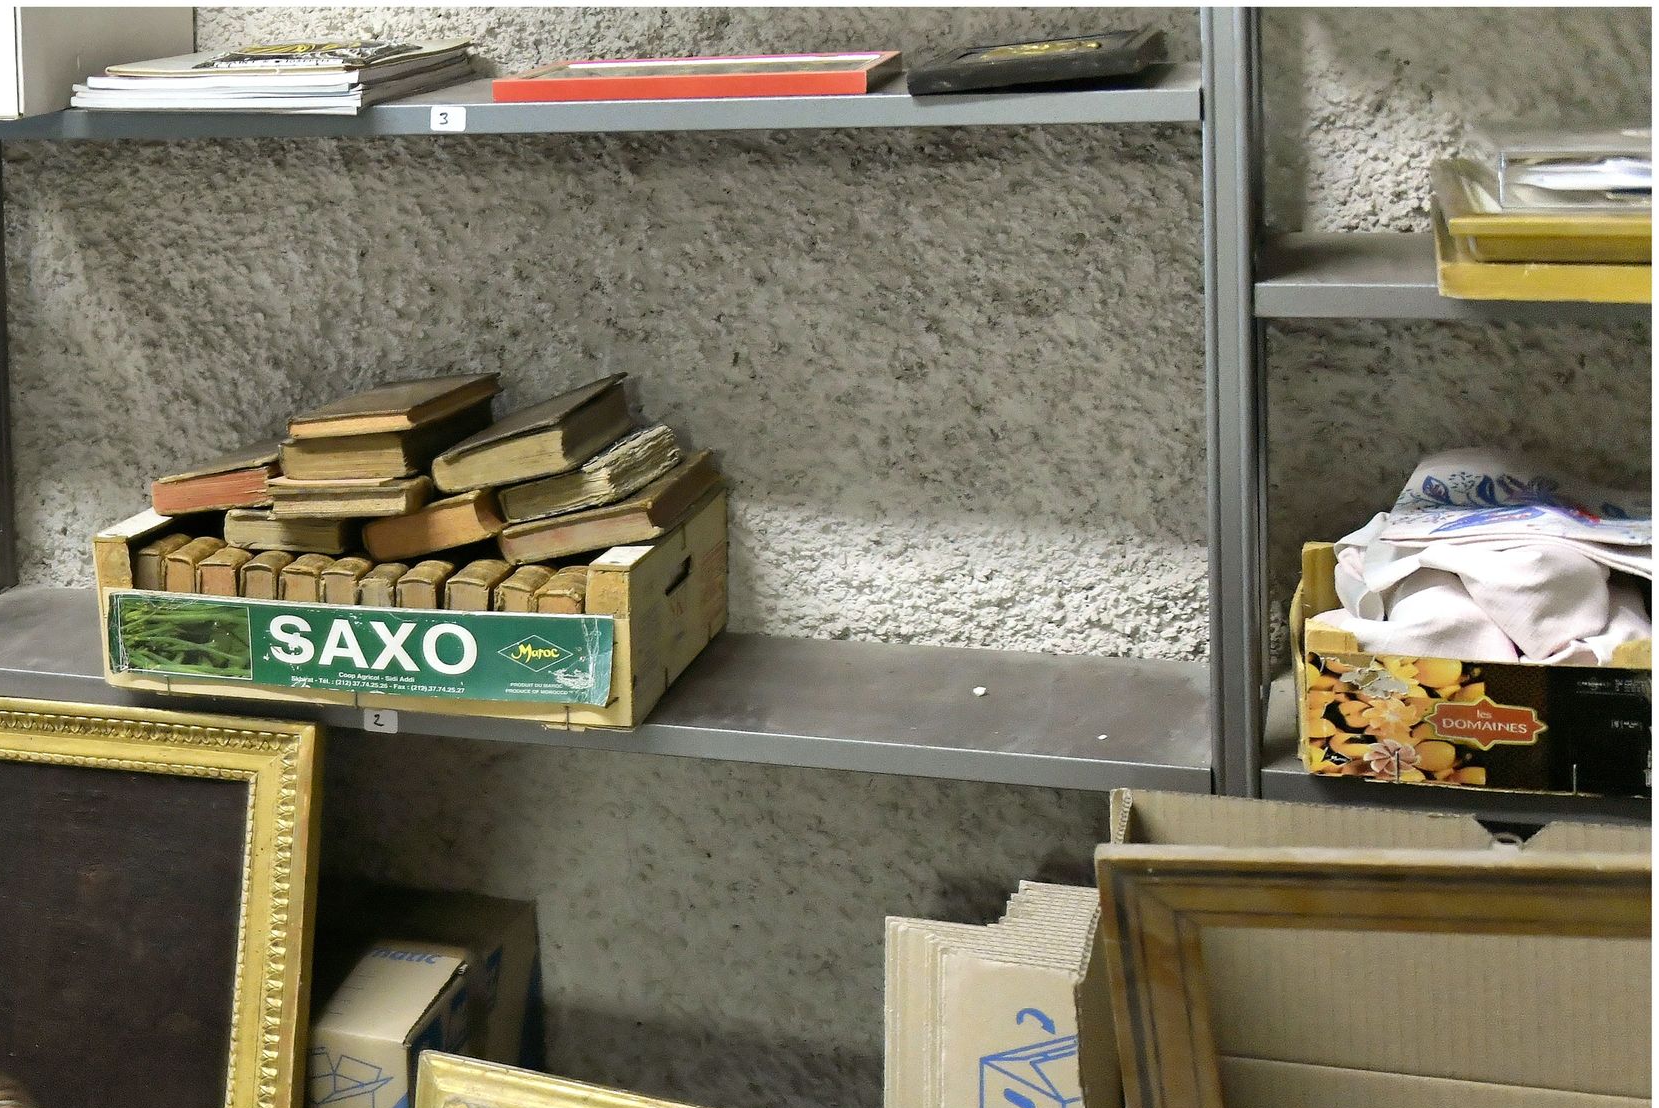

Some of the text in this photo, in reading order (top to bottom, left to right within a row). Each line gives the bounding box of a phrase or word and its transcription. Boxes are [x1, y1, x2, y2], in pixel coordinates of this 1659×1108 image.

[439, 112, 449, 125] 3
[269, 614, 479, 675] SAXO
[511, 643, 560, 664] Maroc
[338, 671, 356, 679] Coop
[357, 673, 380, 681] Agricol
[1477, 708, 1492, 719] les
[1442, 718, 1528, 734] DOMAINES
